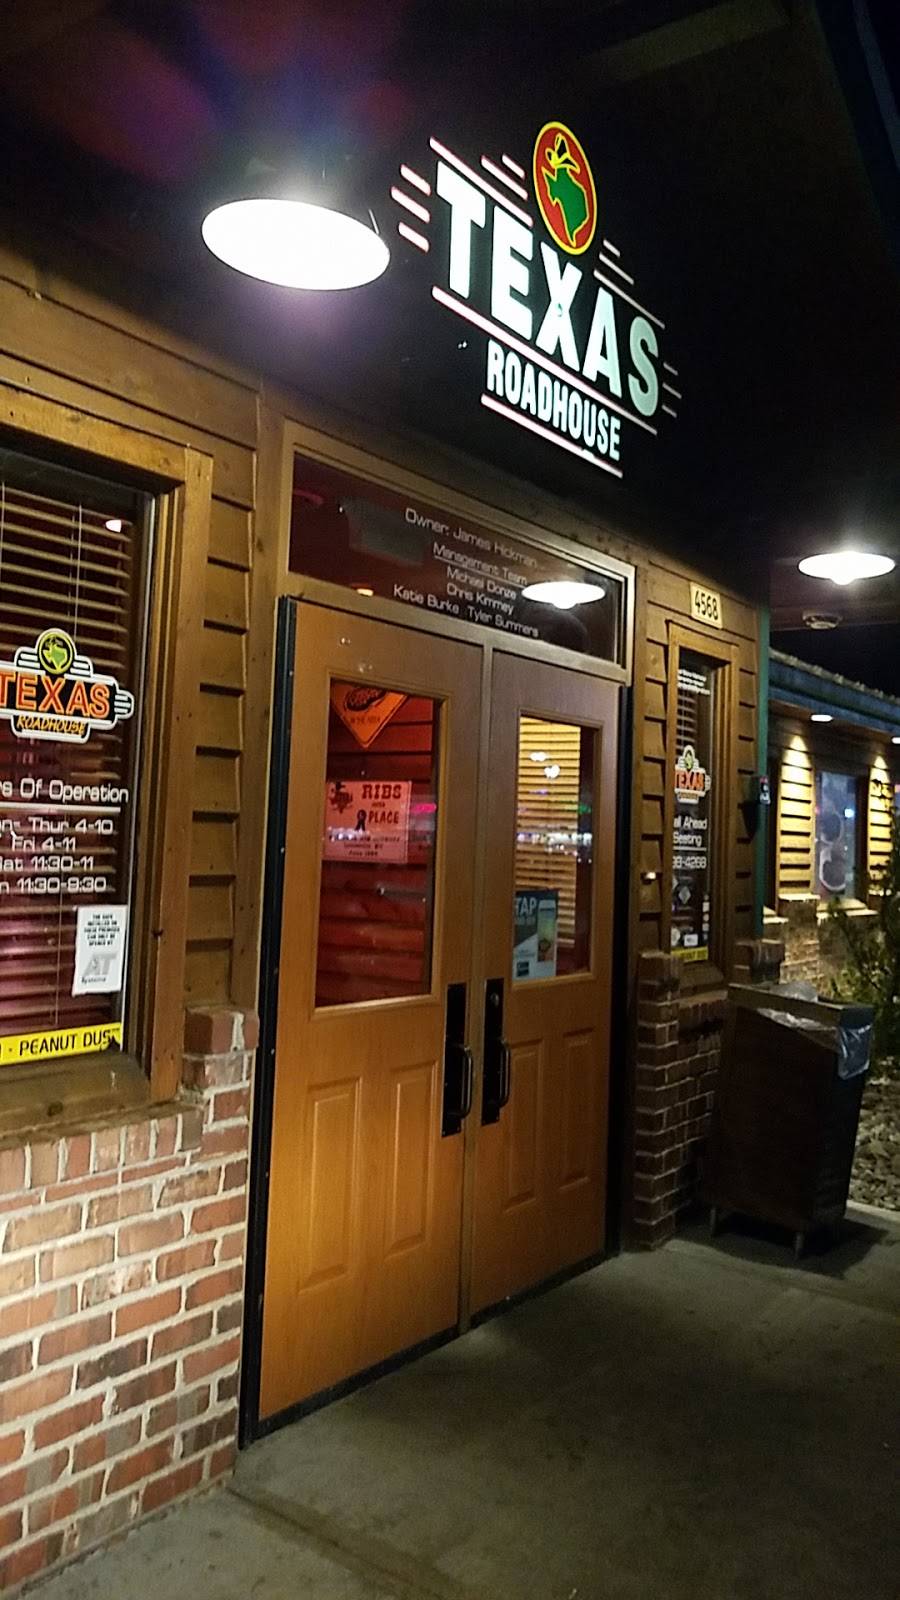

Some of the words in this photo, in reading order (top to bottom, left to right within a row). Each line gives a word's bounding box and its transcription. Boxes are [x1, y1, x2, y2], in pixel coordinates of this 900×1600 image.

[437, 161, 659, 417] TEXAS
[486, 339, 621, 461] ROADHOUSE
[405, 507, 450, 536] Owner:
[453, 528, 491, 551] James
[433, 541, 500, 576] Management
[502, 567, 528, 586] Team
[447, 565, 484, 589] Michael
[394, 584, 424, 604] Katie
[427, 594, 459, 614] Burke
[468, 605, 492, 622] Tyler
[446, 582, 473, 602] Chris
[695, 590, 718, 620] 4568
[0, 671, 110, 719] TEXAS
[16, 715, 87, 735] ROADHOUSE
[20, 777, 43, 799] Of
[49, 779, 129, 804] Operation
[362, 784, 402, 800] RIBS
[28, 816, 69, 834] Thur
[74, 817, 114, 835] 4-10
[368, 810, 399, 825] PLACE
[11, 835, 36, 852] Fri
[41, 836, 77, 852] 4-11
[31, 855, 95, 872] 11:30-11
[19, 1033, 77, 1057] PEANUT
